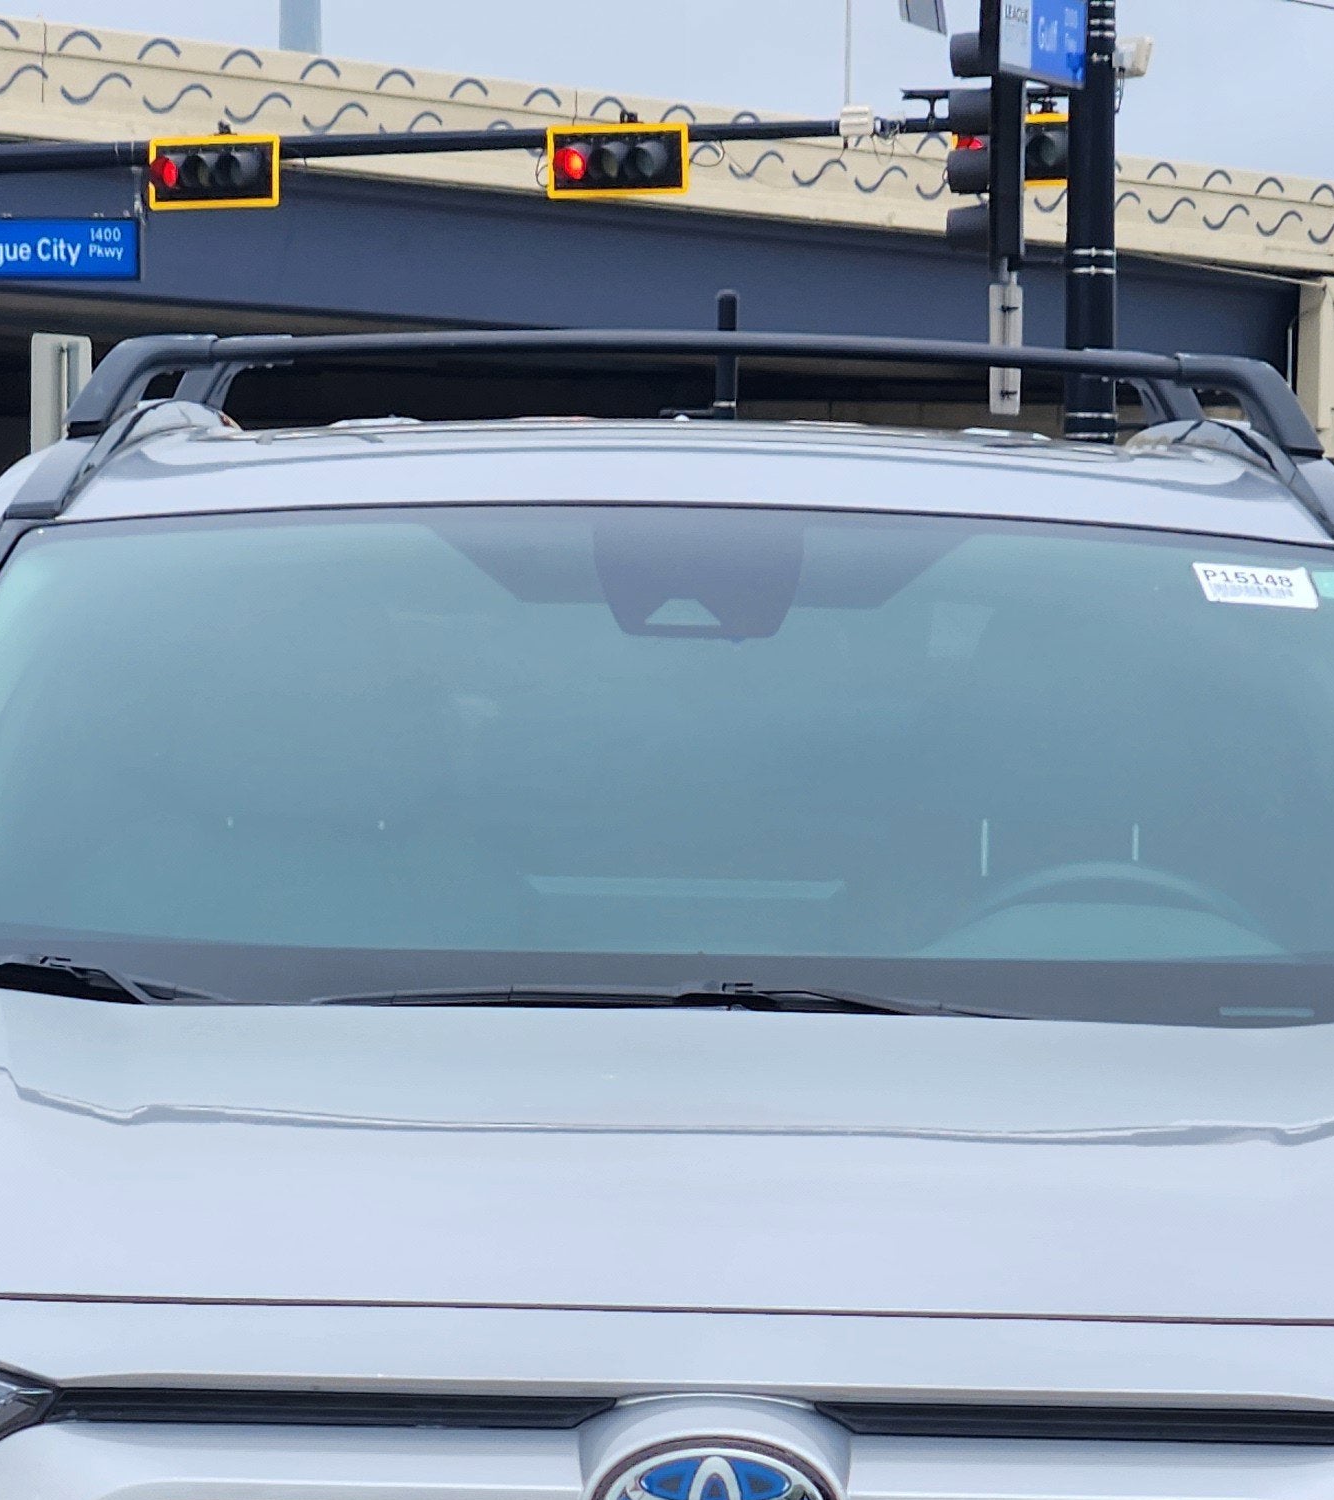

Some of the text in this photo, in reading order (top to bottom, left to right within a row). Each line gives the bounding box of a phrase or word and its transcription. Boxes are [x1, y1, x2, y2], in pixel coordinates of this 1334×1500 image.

[90, 227, 121, 242] 1400
[37, 237, 81, 268] City
[89, 243, 123, 261] Pkwy
[1203, 569, 1293, 588] P15148
